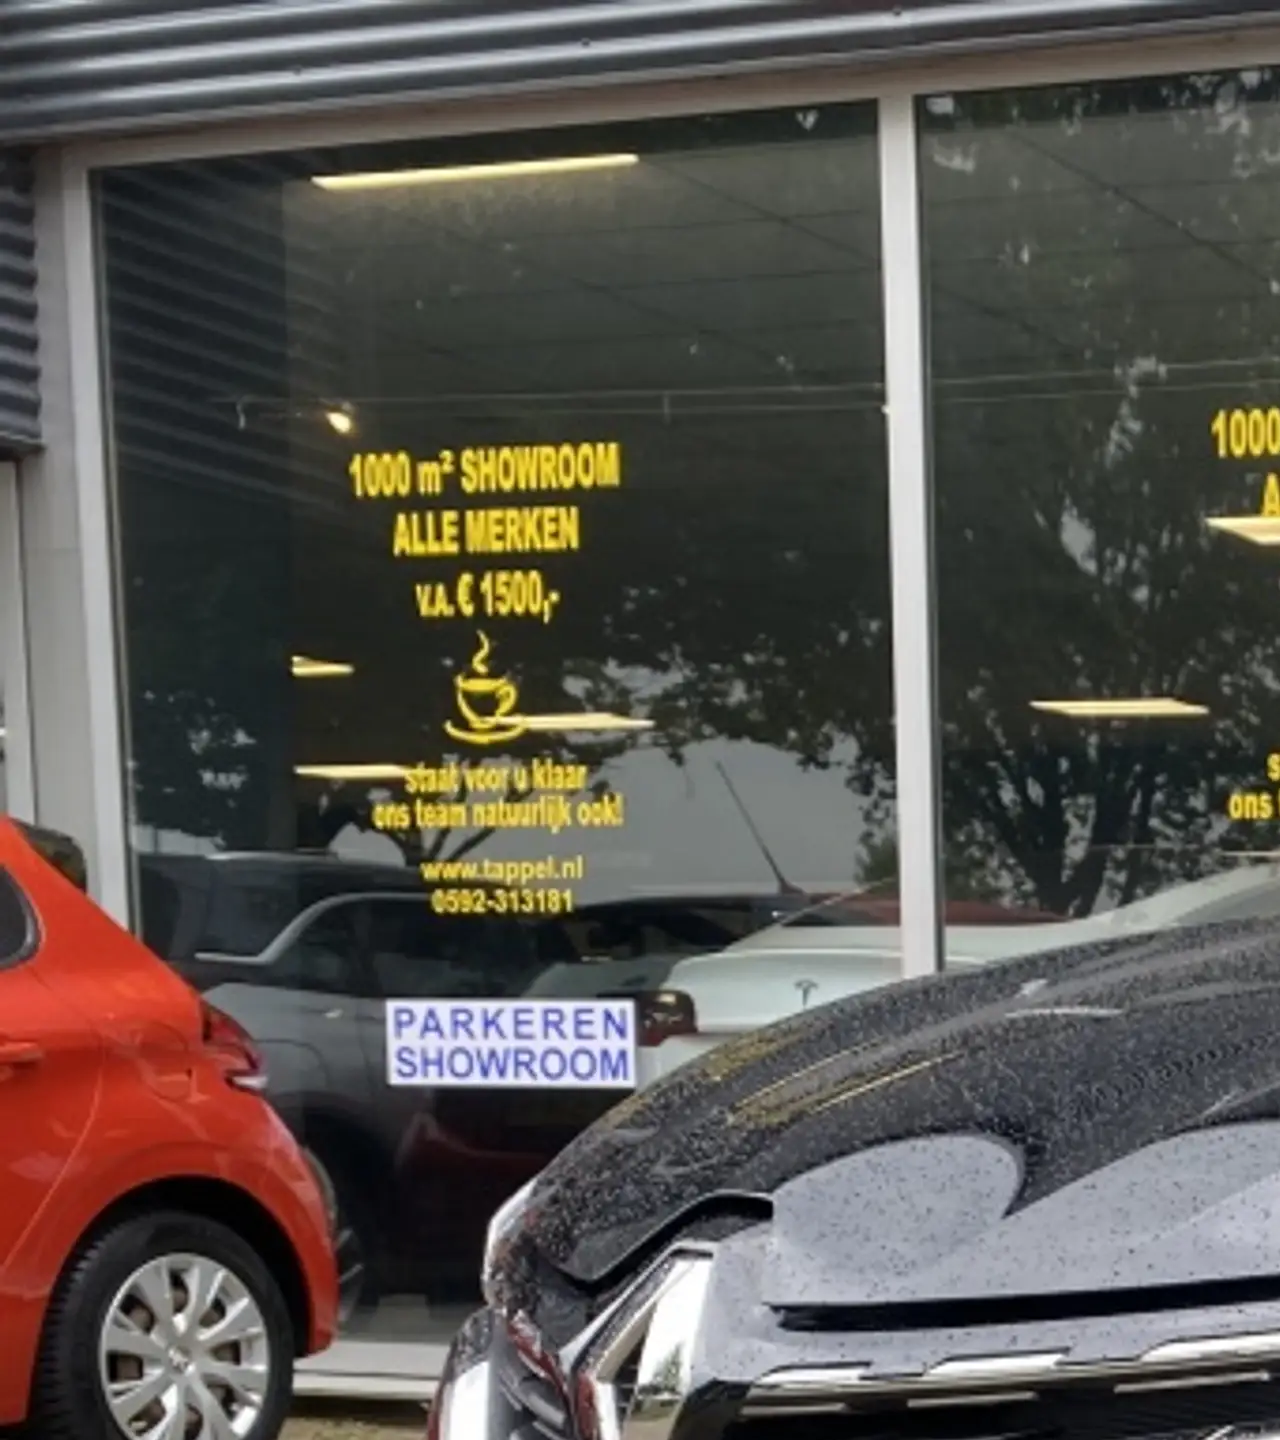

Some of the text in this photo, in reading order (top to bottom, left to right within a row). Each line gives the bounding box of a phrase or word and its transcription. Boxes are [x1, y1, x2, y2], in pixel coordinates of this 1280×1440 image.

[348, 451, 410, 497] 1000
[459, 442, 622, 493] SHOWROOM
[392, 506, 580, 557] ALLE MERKEN
[457, 573, 475, 616] €
[404, 758, 588, 795] staat voor u klaar
[372, 793, 624, 833] ons team natuurlijk ook!
[1229, 793, 1273, 820] ons
[420, 856, 584, 886] www.tappel.nl
[430, 888, 574, 915] 0592-313181
[393, 1005, 629, 1041] PARKEREN
[394, 1044, 631, 1082] SHOWROOM
